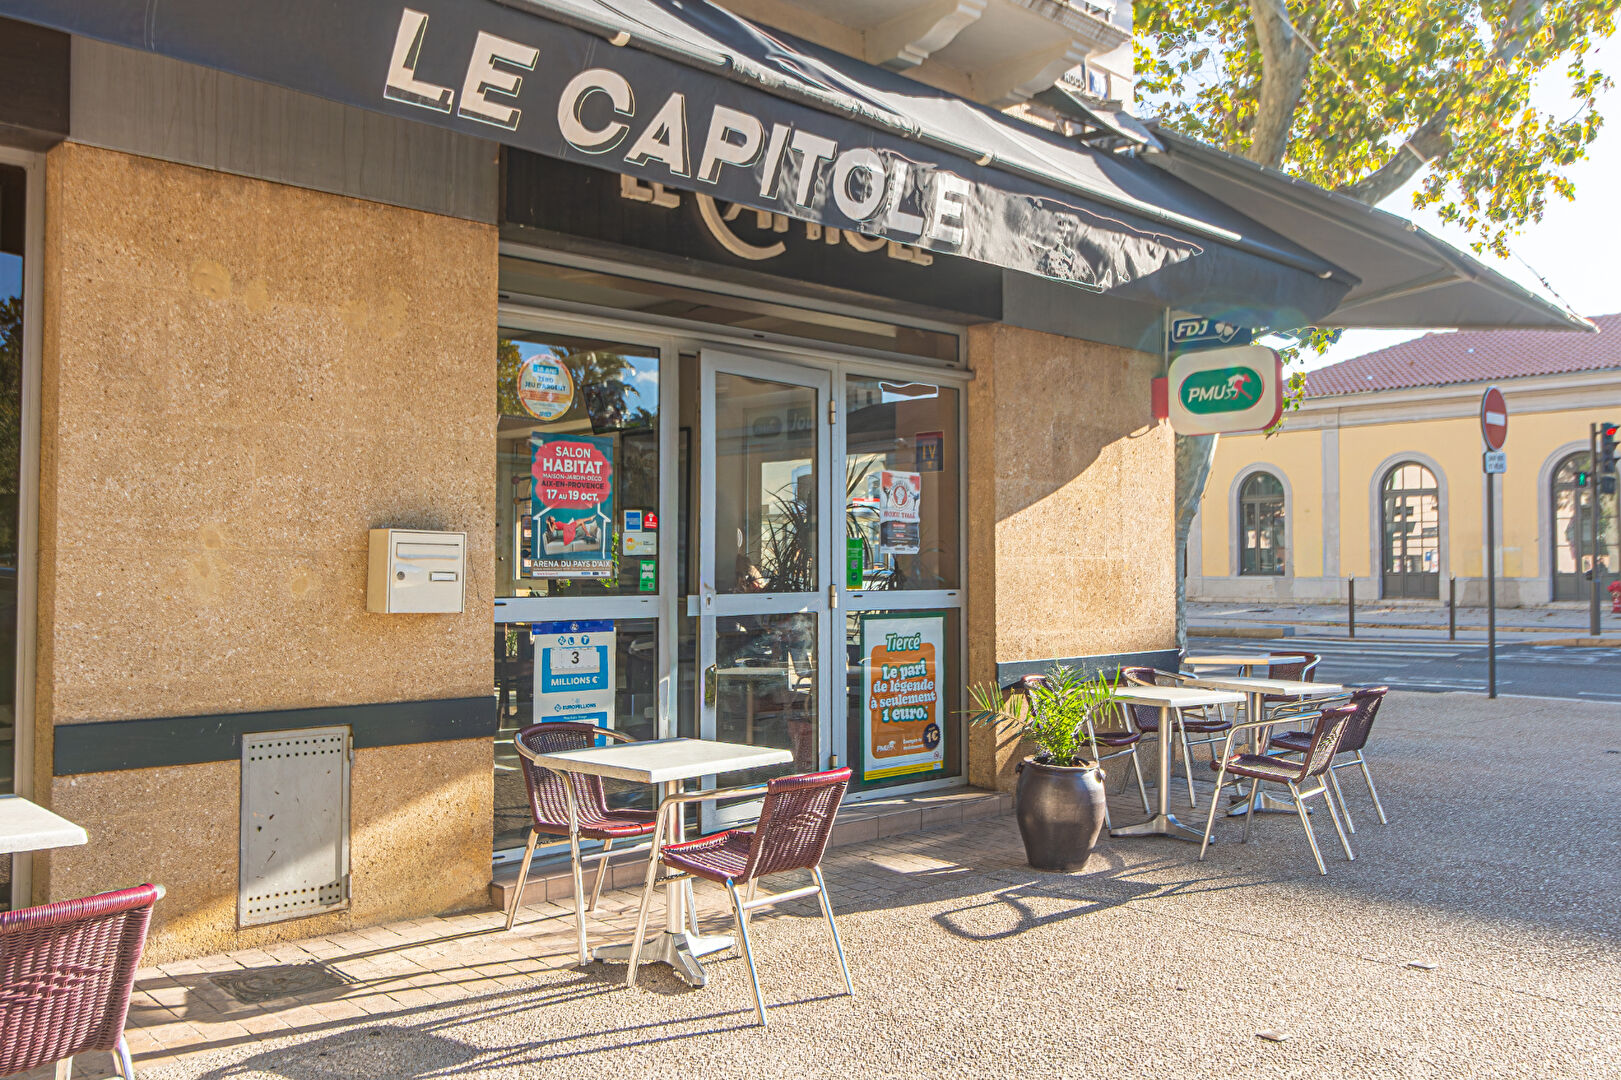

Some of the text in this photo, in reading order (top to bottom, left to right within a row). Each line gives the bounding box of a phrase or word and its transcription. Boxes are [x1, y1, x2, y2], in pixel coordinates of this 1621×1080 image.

[383, 8, 540, 131] LE
[557, 69, 970, 246] CAPITOLE
[1176, 320, 1209, 338] FDJ
[1188, 384, 1226, 404] PMU
[555, 446, 591, 459] SALON
[543, 458, 603, 474] HABITAT
[541, 480, 605, 490] AIX-EN-PROVENCE
[546, 489, 558, 500] 17
[568, 490, 580, 501] 19
[580, 492, 600, 502] OCT.
[533, 560, 612, 568] ARENA DU PAYS D'AIX
[886, 632, 921, 652] Tiercé
[571, 651, 580, 665] 3
[882, 658, 927, 681] Le pari
[551, 676, 591, 686] MILLIONS
[873, 678, 934, 694] de légende
[870, 691, 936, 709] à seulement
[882, 707, 890, 721] 1
[926, 730, 939, 743] 1€
